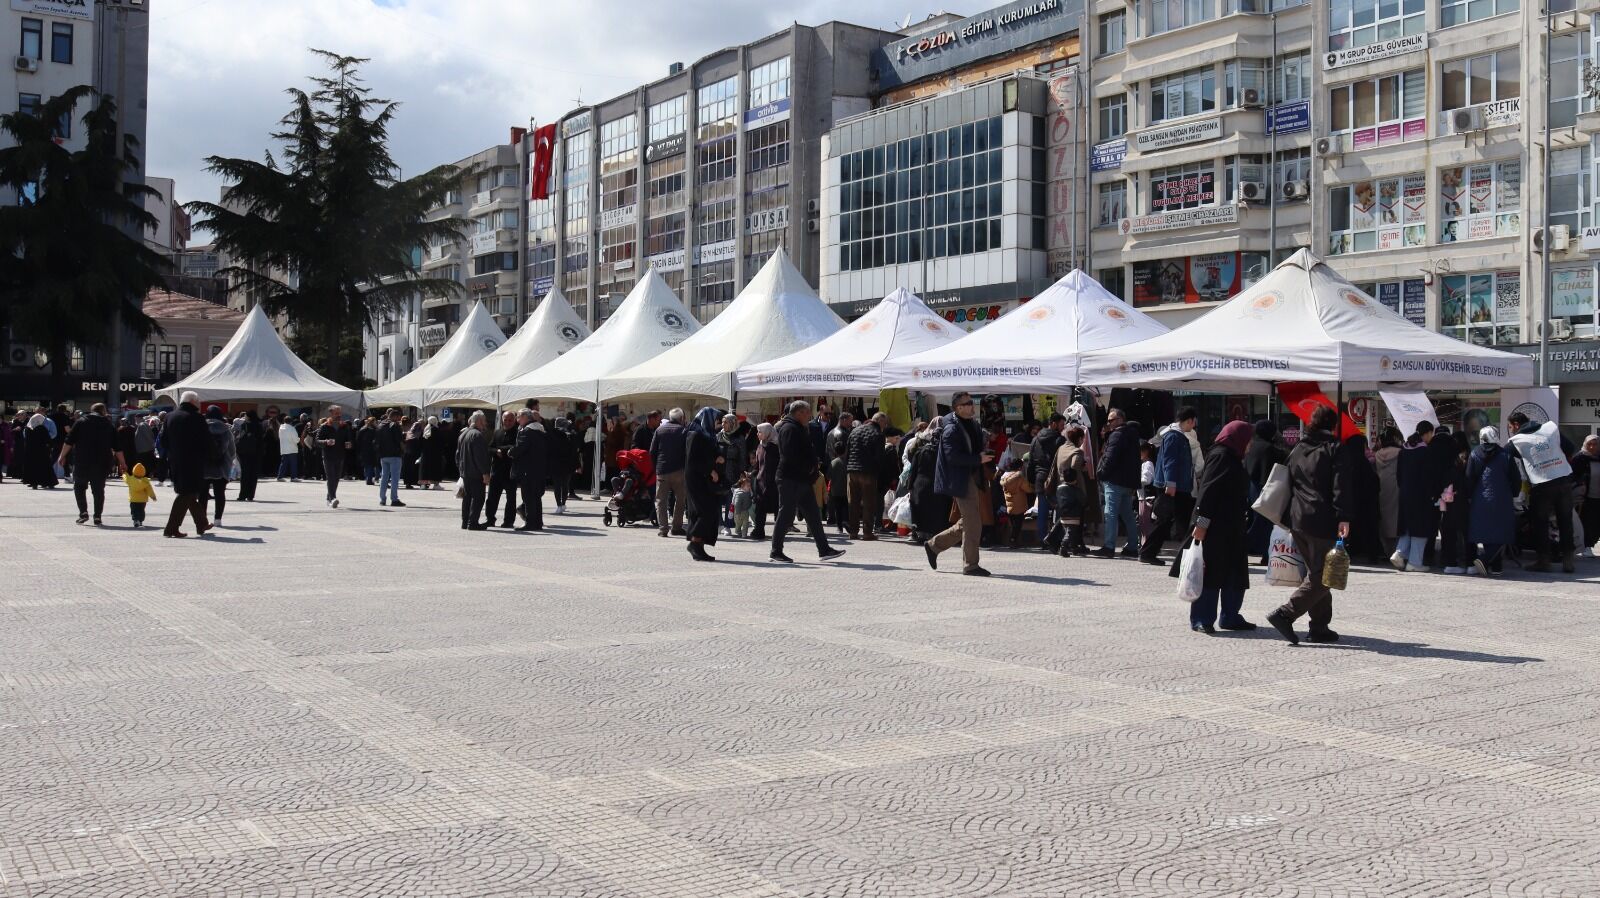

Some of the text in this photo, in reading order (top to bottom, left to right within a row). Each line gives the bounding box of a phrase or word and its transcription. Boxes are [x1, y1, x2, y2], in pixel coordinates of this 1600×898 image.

[907, 0, 1057, 57] ÇÖZÜM EĞİTİM KURUMLARI
[1347, 49, 1366, 59] GRUP
[1367, 44, 1386, 55] ÖZEL
[1387, 35, 1423, 50] GÜVENLİK
[1138, 136, 1150, 144] ÖZEL
[1049, 76, 1071, 246] ÇÖZÜM
[1165, 212, 1190, 225] İŞİTME
[1191, 206, 1234, 221] CİHAZLARI
[1384, 284, 1396, 295] VIP
[1549, 349, 1587, 361] TEVFİK
[1131, 356, 1291, 373] SAMSUN BÜYÜKŞEHİR BELEDİYESİ
[1392, 358, 1508, 378] SAMSUN BÜYÜKŞEHİR BELEDİYESİ
[1562, 360, 1599, 373] İŞHANI
[765, 372, 856, 384] SAMSUN BÜYÜKŞEHİR BELEDİYESİ
[922, 364, 1042, 379] SAMSUN BÜYÜKŞEHİR BELEDİYESİ
[82, 381, 156, 392] REN OPTİK
[1571, 399, 1583, 407] DR.
[443, 409, 449, 418] P
